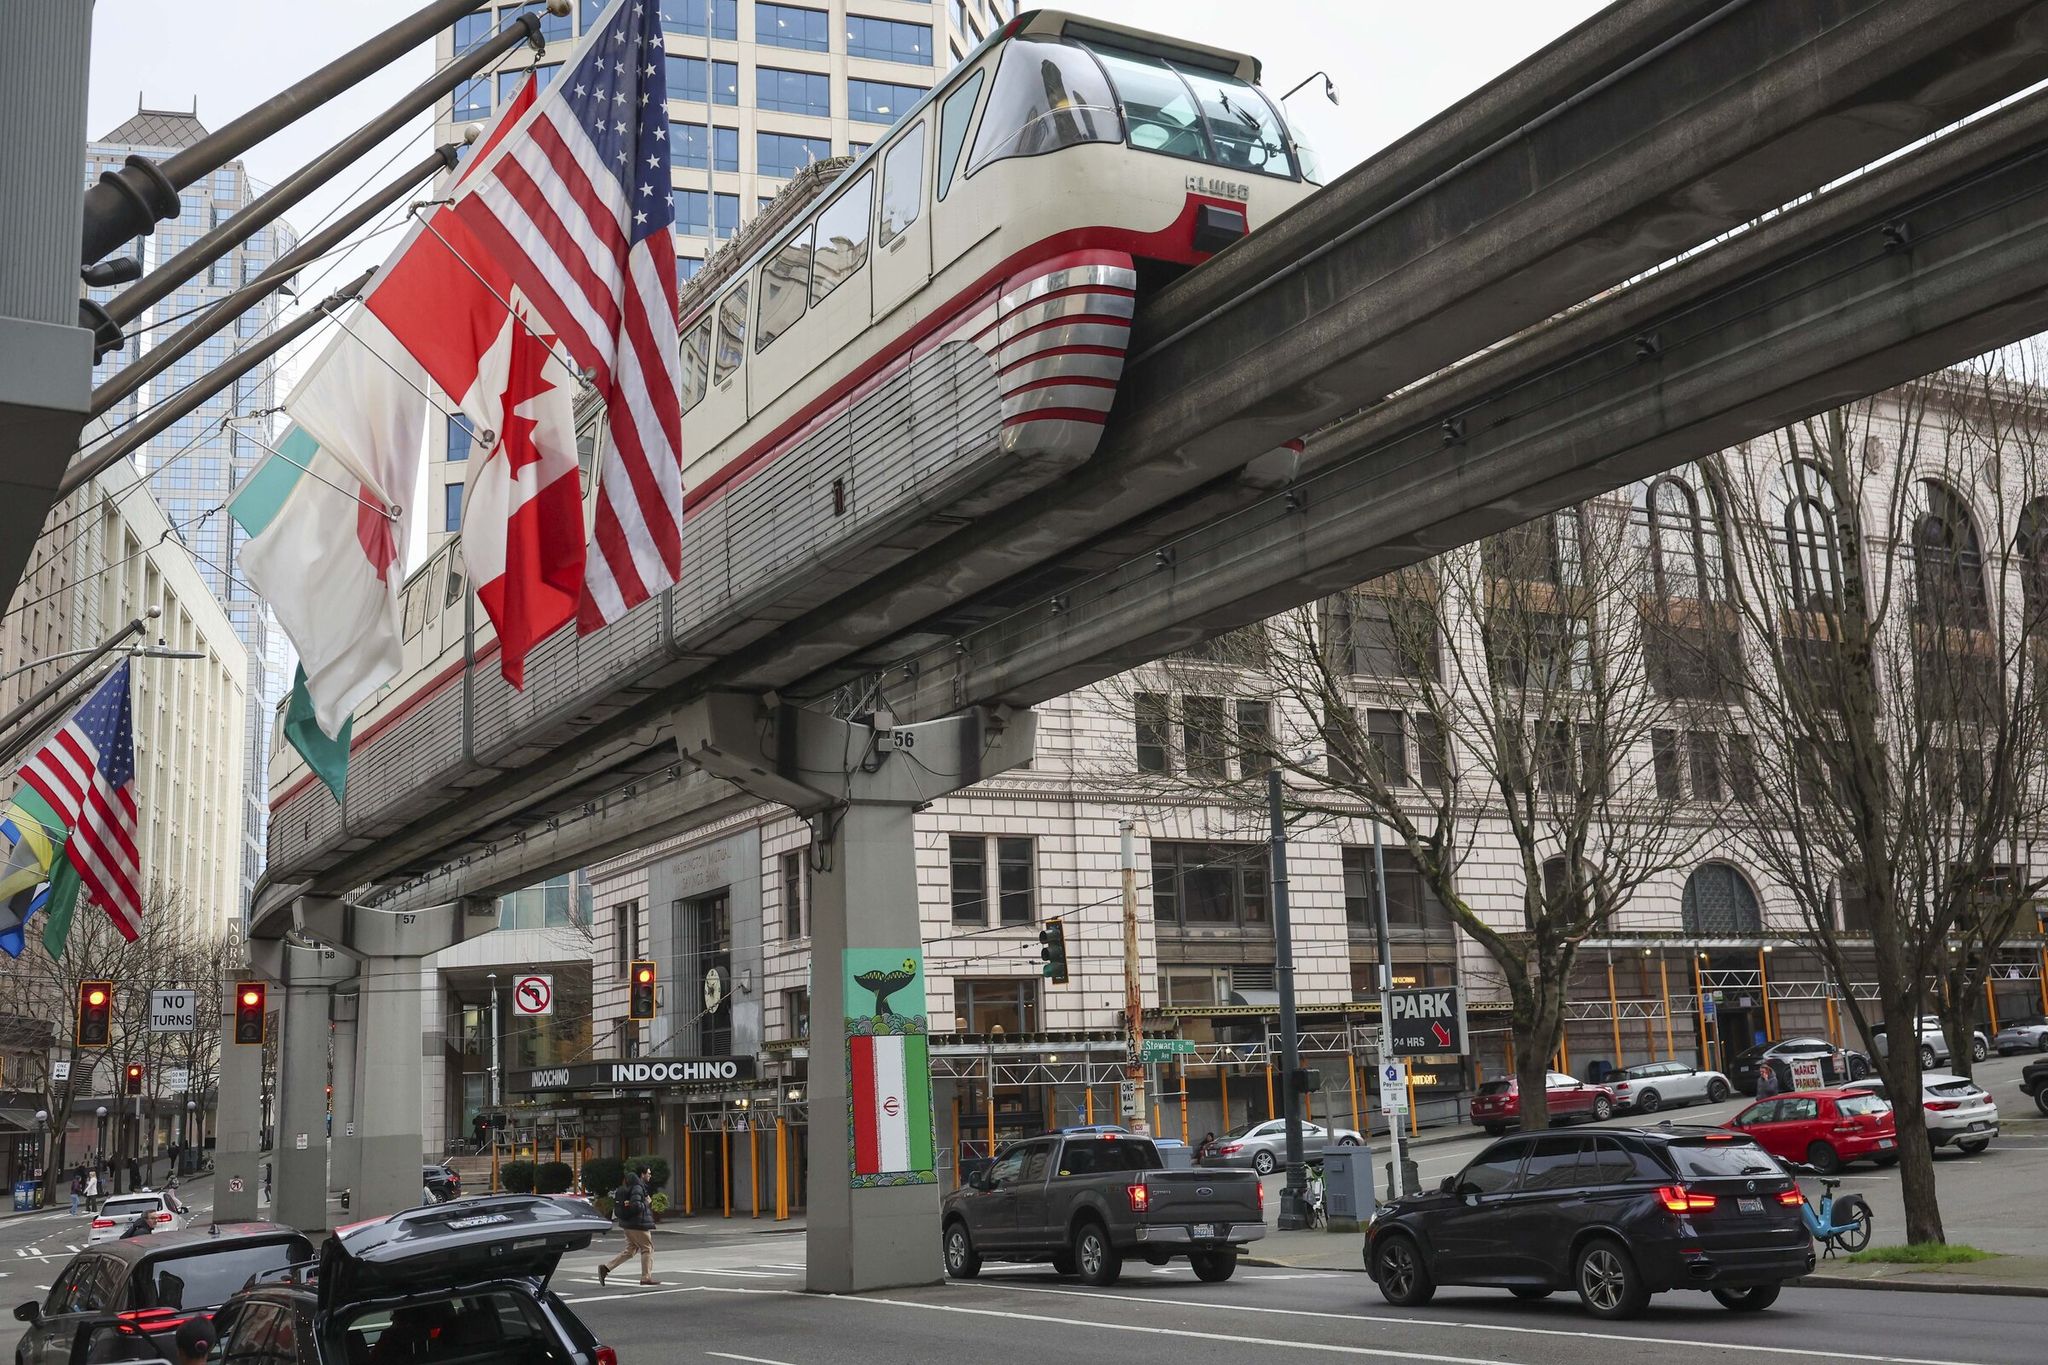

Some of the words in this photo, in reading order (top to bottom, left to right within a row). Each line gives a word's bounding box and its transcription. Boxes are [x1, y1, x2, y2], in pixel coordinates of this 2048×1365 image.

[894, 731, 915, 748] 56
[403, 914, 416, 925] 57
[324, 951, 335, 959] 58
[163, 996, 185, 1009] NO
[1391, 992, 1453, 1020] PARK
[152, 1014, 193, 1026] TURNS
[1145, 1040, 1175, 1051] Stewart
[1406, 1036, 1425, 1047] HRS
[1160, 1052, 1170, 1060] Ave
[612, 1061, 738, 1082] INDOCHINO
[1793, 1064, 1818, 1076] MARKET
[531, 1068, 570, 1088] INDOCHINO
[1122, 1083, 1134, 1092] ONE
[1122, 1093, 1134, 1102] WAY
